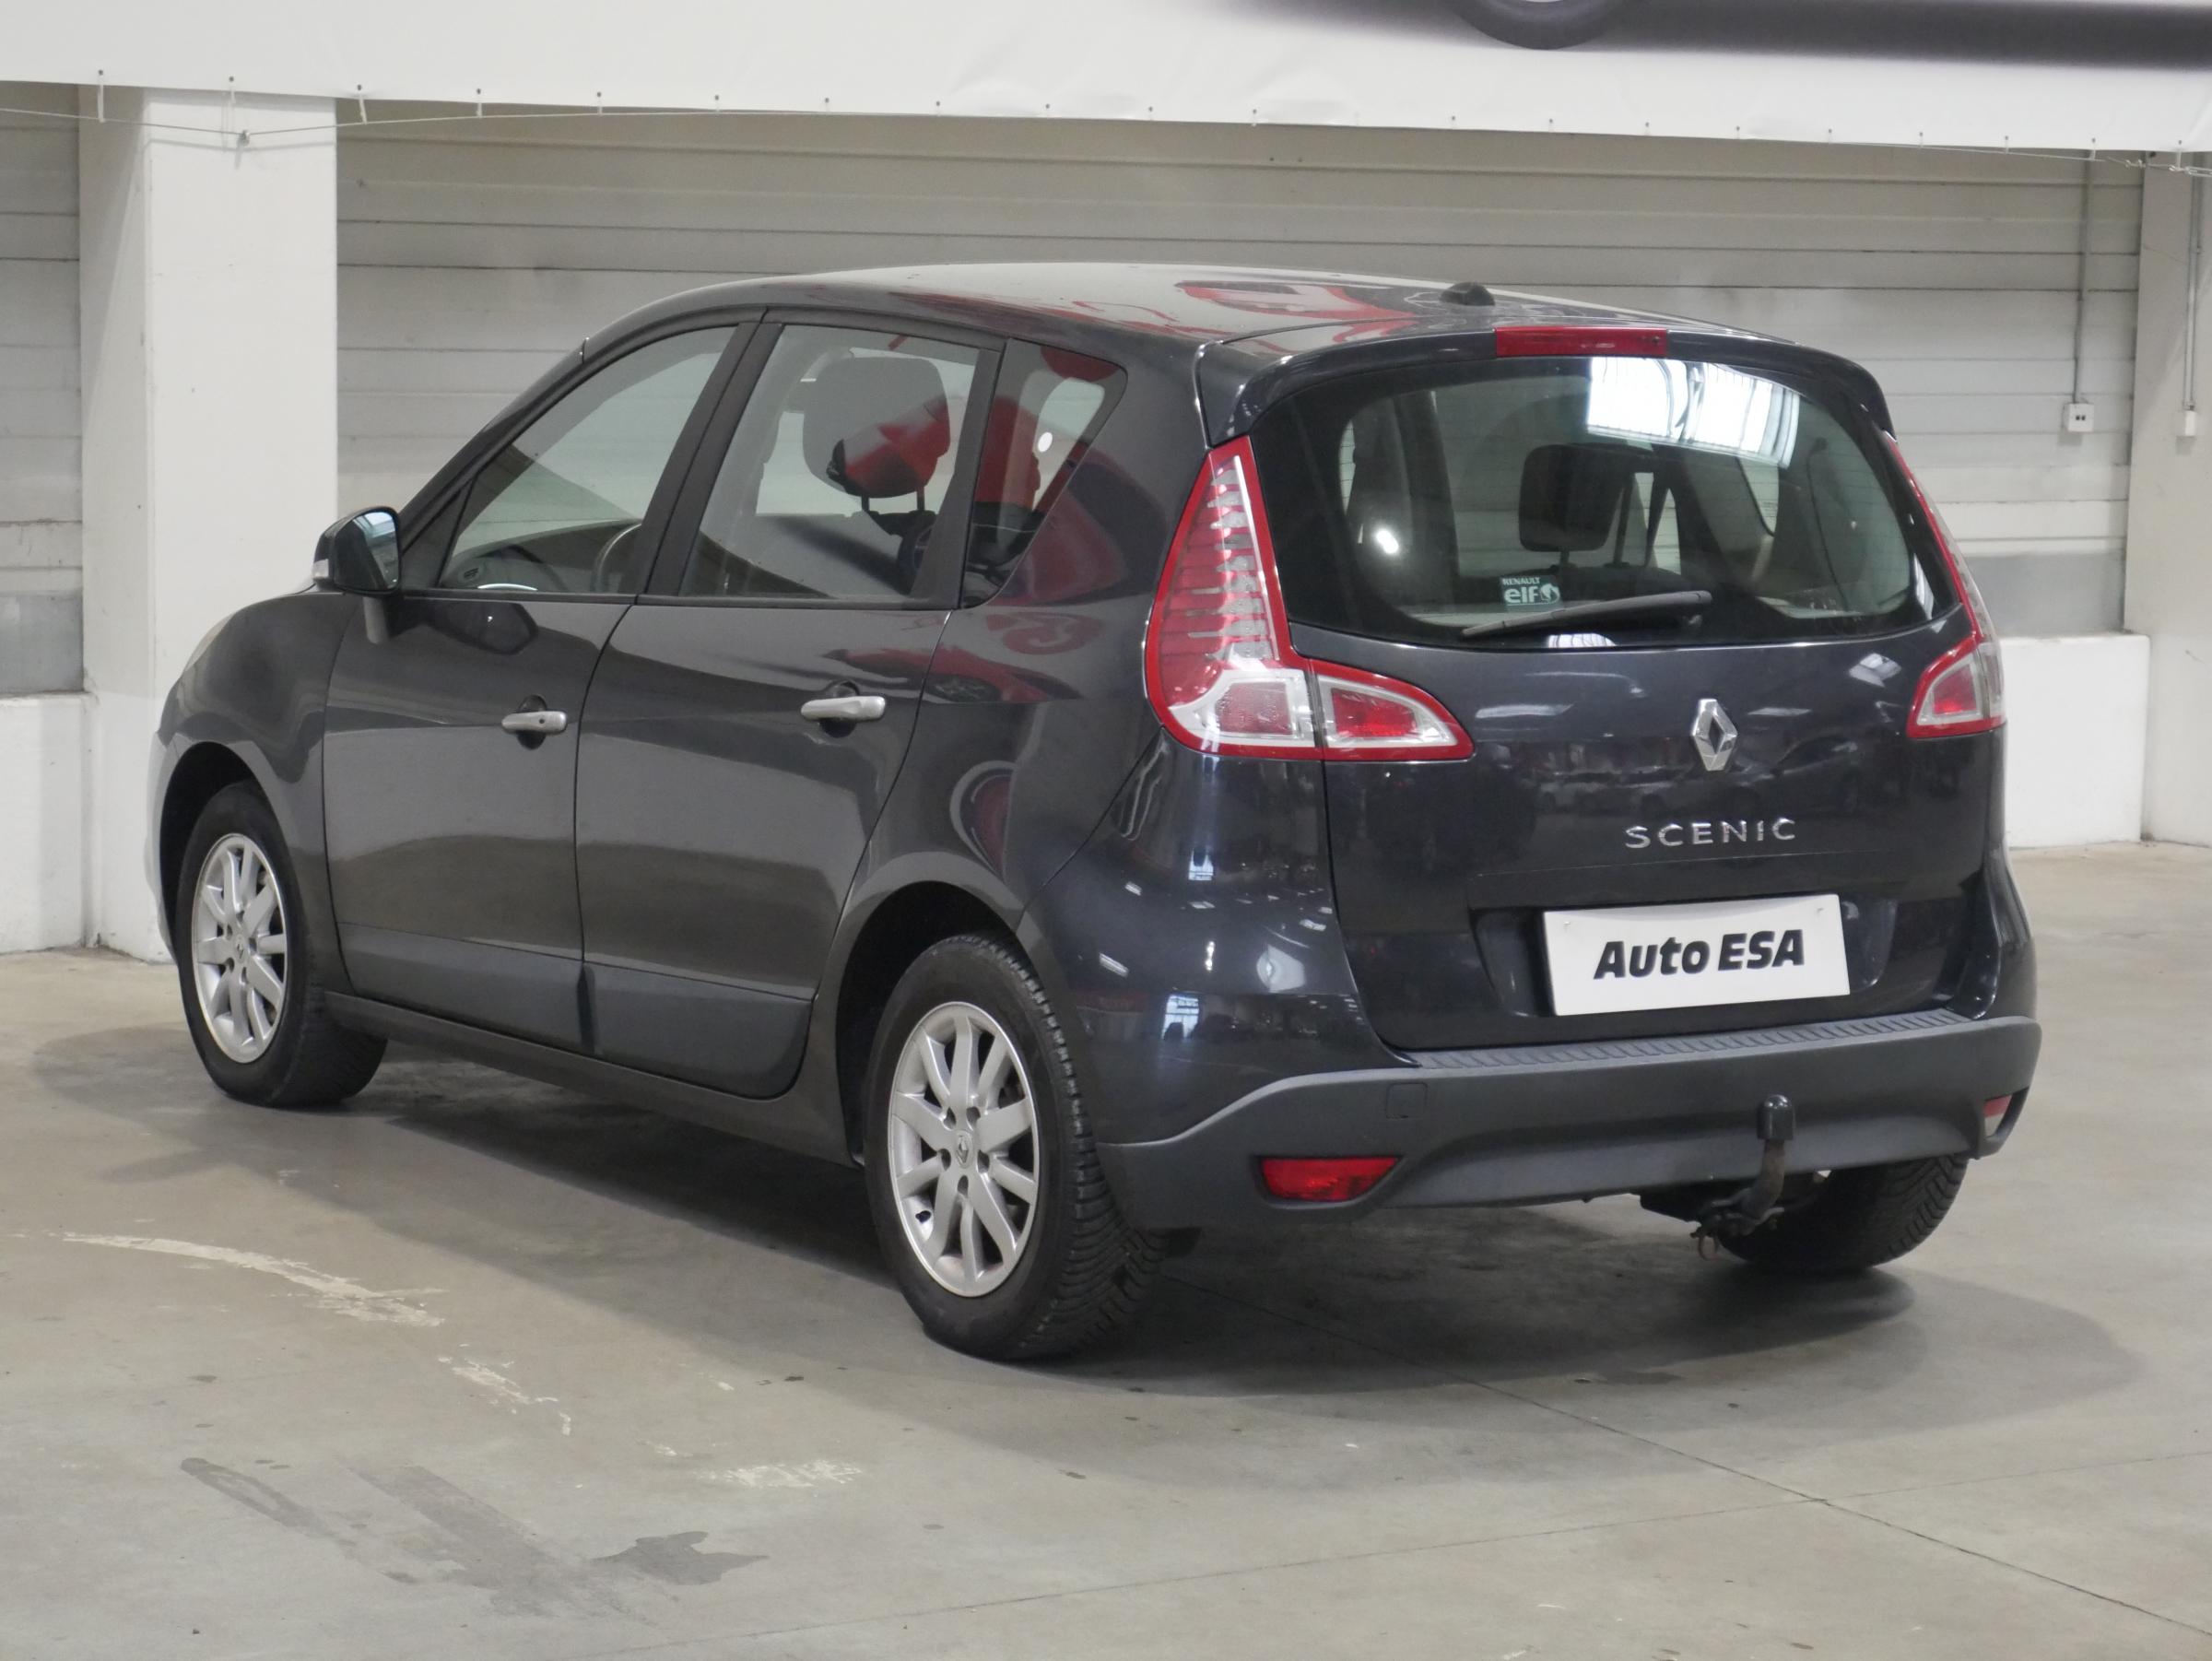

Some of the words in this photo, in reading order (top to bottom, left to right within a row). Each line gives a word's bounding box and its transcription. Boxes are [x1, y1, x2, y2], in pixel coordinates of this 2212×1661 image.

[1502, 577, 1540, 585] RENAULT
[1505, 586, 1539, 603] elf
[1625, 818, 1795, 849] SCENIC
[1594, 937, 1711, 979] Auto
[1717, 929, 1805, 971] ESA
